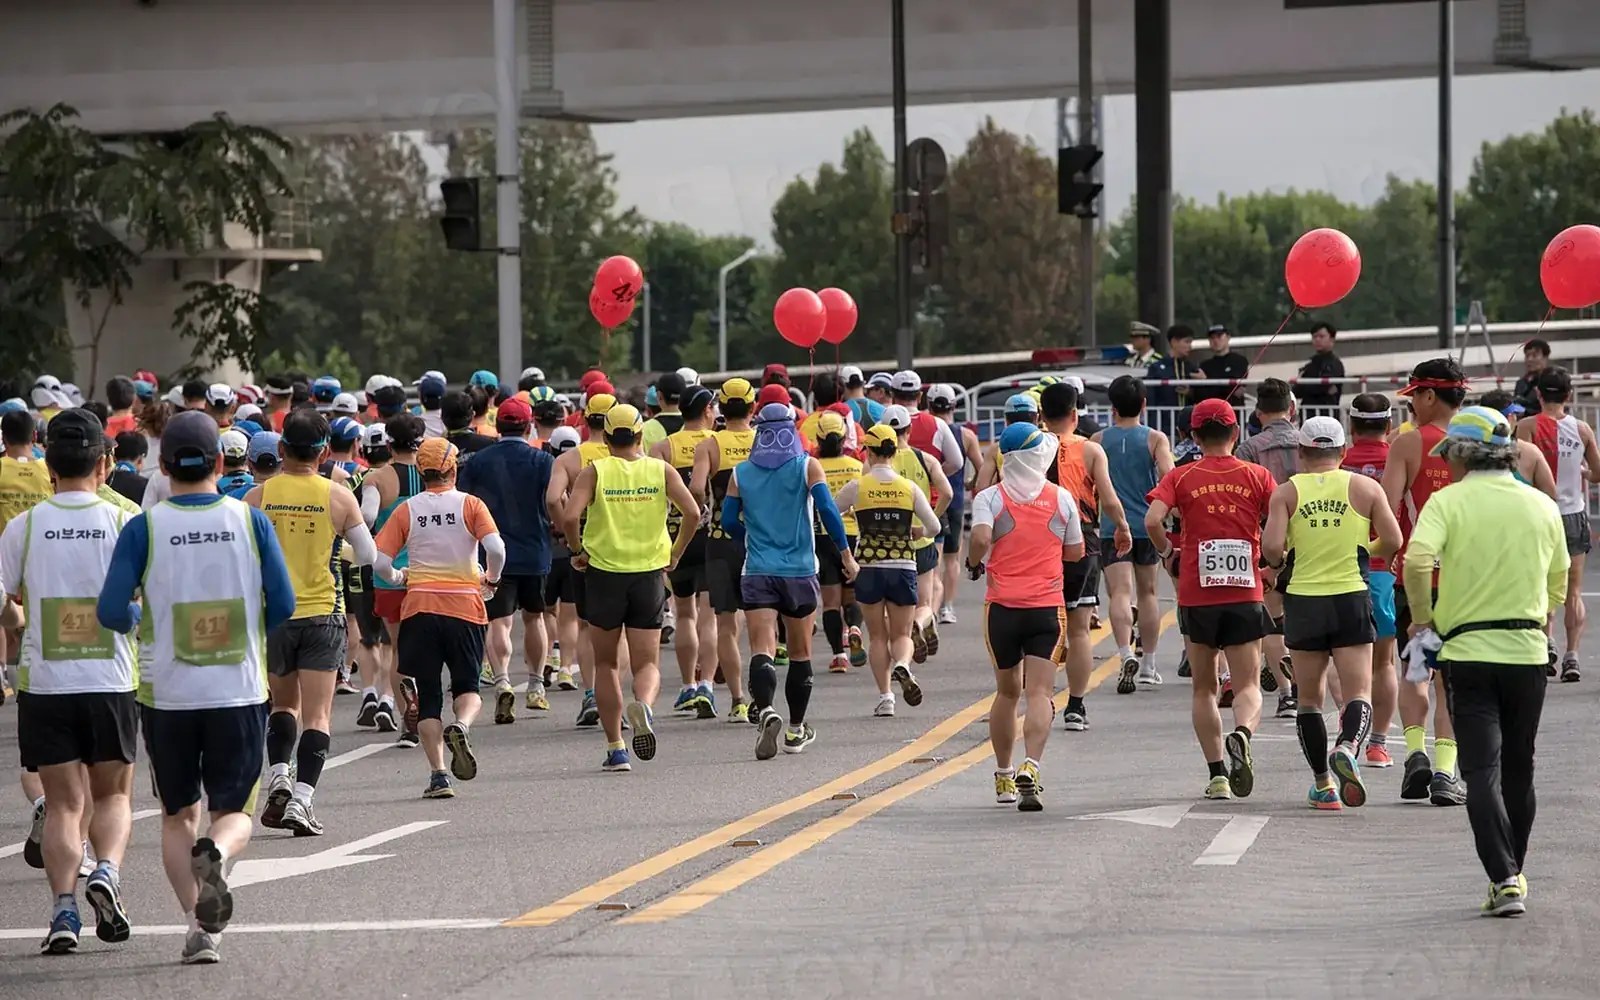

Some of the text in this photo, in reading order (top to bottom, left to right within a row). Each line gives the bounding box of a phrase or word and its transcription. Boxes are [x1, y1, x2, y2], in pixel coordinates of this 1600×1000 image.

[637, 485, 660, 494] Club
[265, 503, 325, 513] Runners Club
[44, 528, 106, 539] 이브자리
[170, 531, 235, 545] 이브자리
[1205, 554, 1248, 572] 5:00
[1205, 576, 1251, 586] Pace Maker
